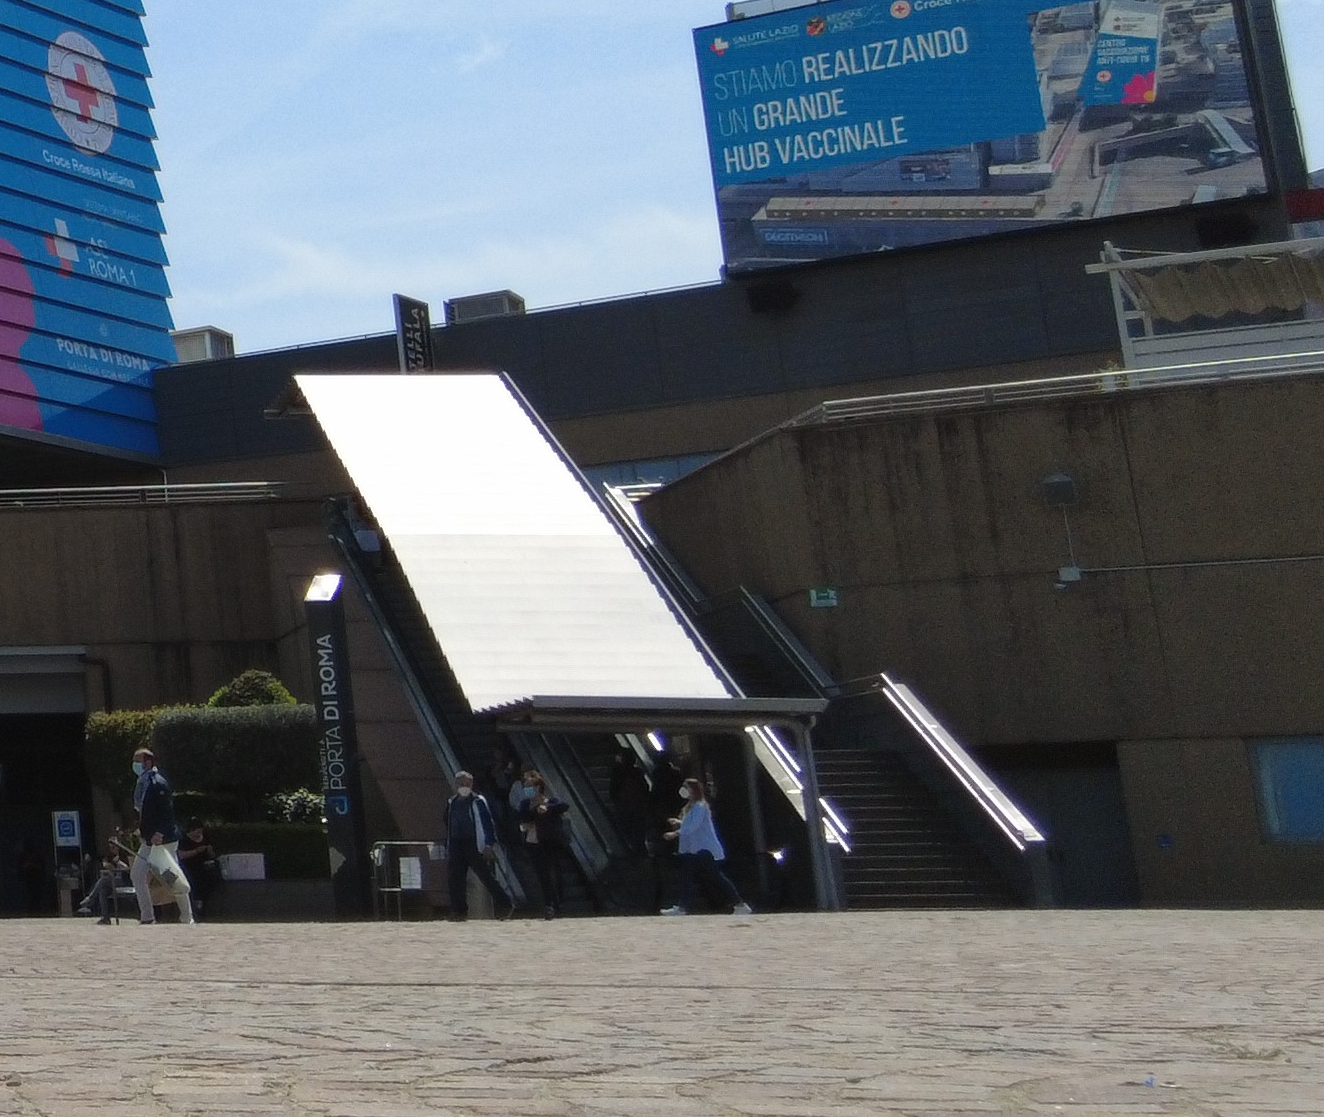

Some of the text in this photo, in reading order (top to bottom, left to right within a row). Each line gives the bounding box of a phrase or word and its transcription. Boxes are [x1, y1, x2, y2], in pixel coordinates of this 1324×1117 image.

[714, 26, 968, 101] STIAMO REALIZZANDO
[718, 88, 847, 137] UN GRANDE
[42, 149, 70, 169] Croce
[72, 158, 101, 179] Rossa
[723, 116, 908, 174] HUB VACCINALE
[88, 258, 137, 287] ROMA 1
[56, 338, 150, 372] PORTA DI ROMA
[316, 634, 346, 790] PORTA DI ROMA
